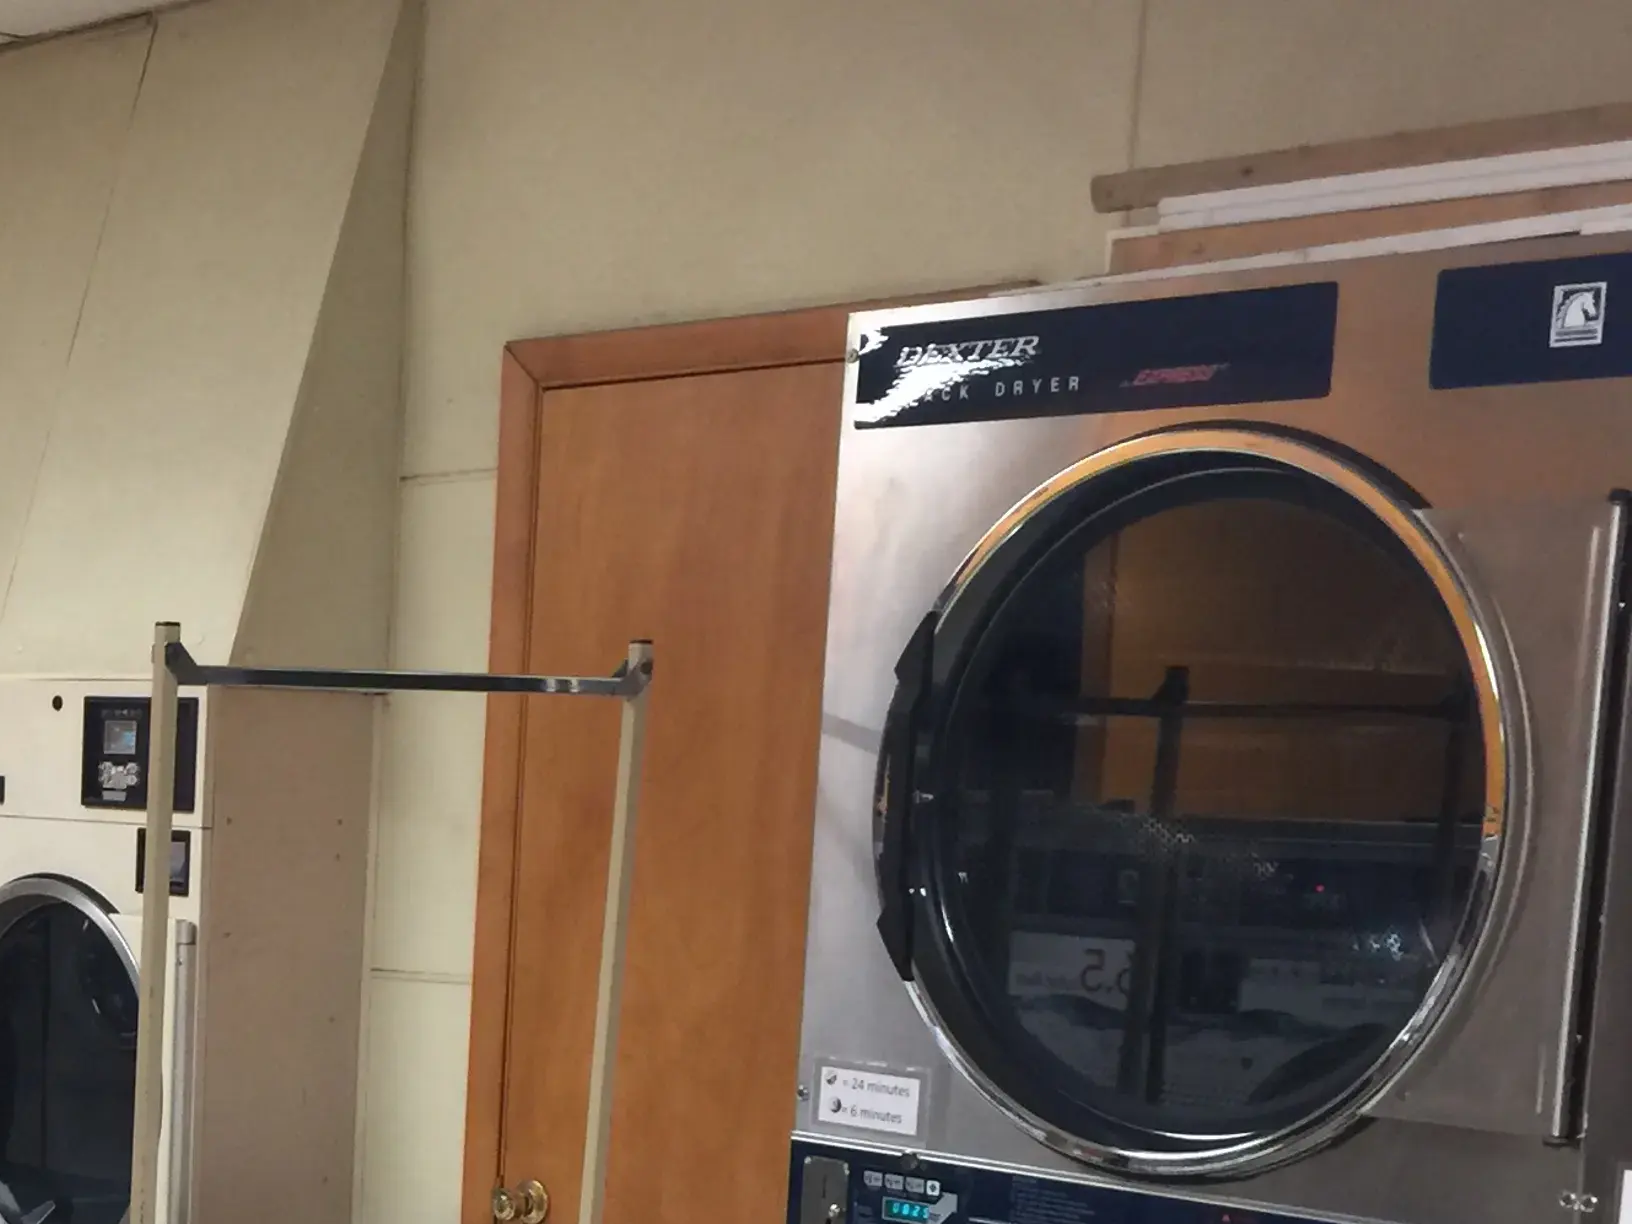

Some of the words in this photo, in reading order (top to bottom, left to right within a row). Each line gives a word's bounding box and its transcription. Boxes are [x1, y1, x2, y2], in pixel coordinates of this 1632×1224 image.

[895, 335, 1040, 365] DEXTER
[995, 376, 1080, 397] DRYER
[851, 1077, 865, 1091] 24
[867, 1082, 911, 1098] minutes
[850, 1104, 858, 1118] 6
[860, 1108, 903, 1124] minutes
